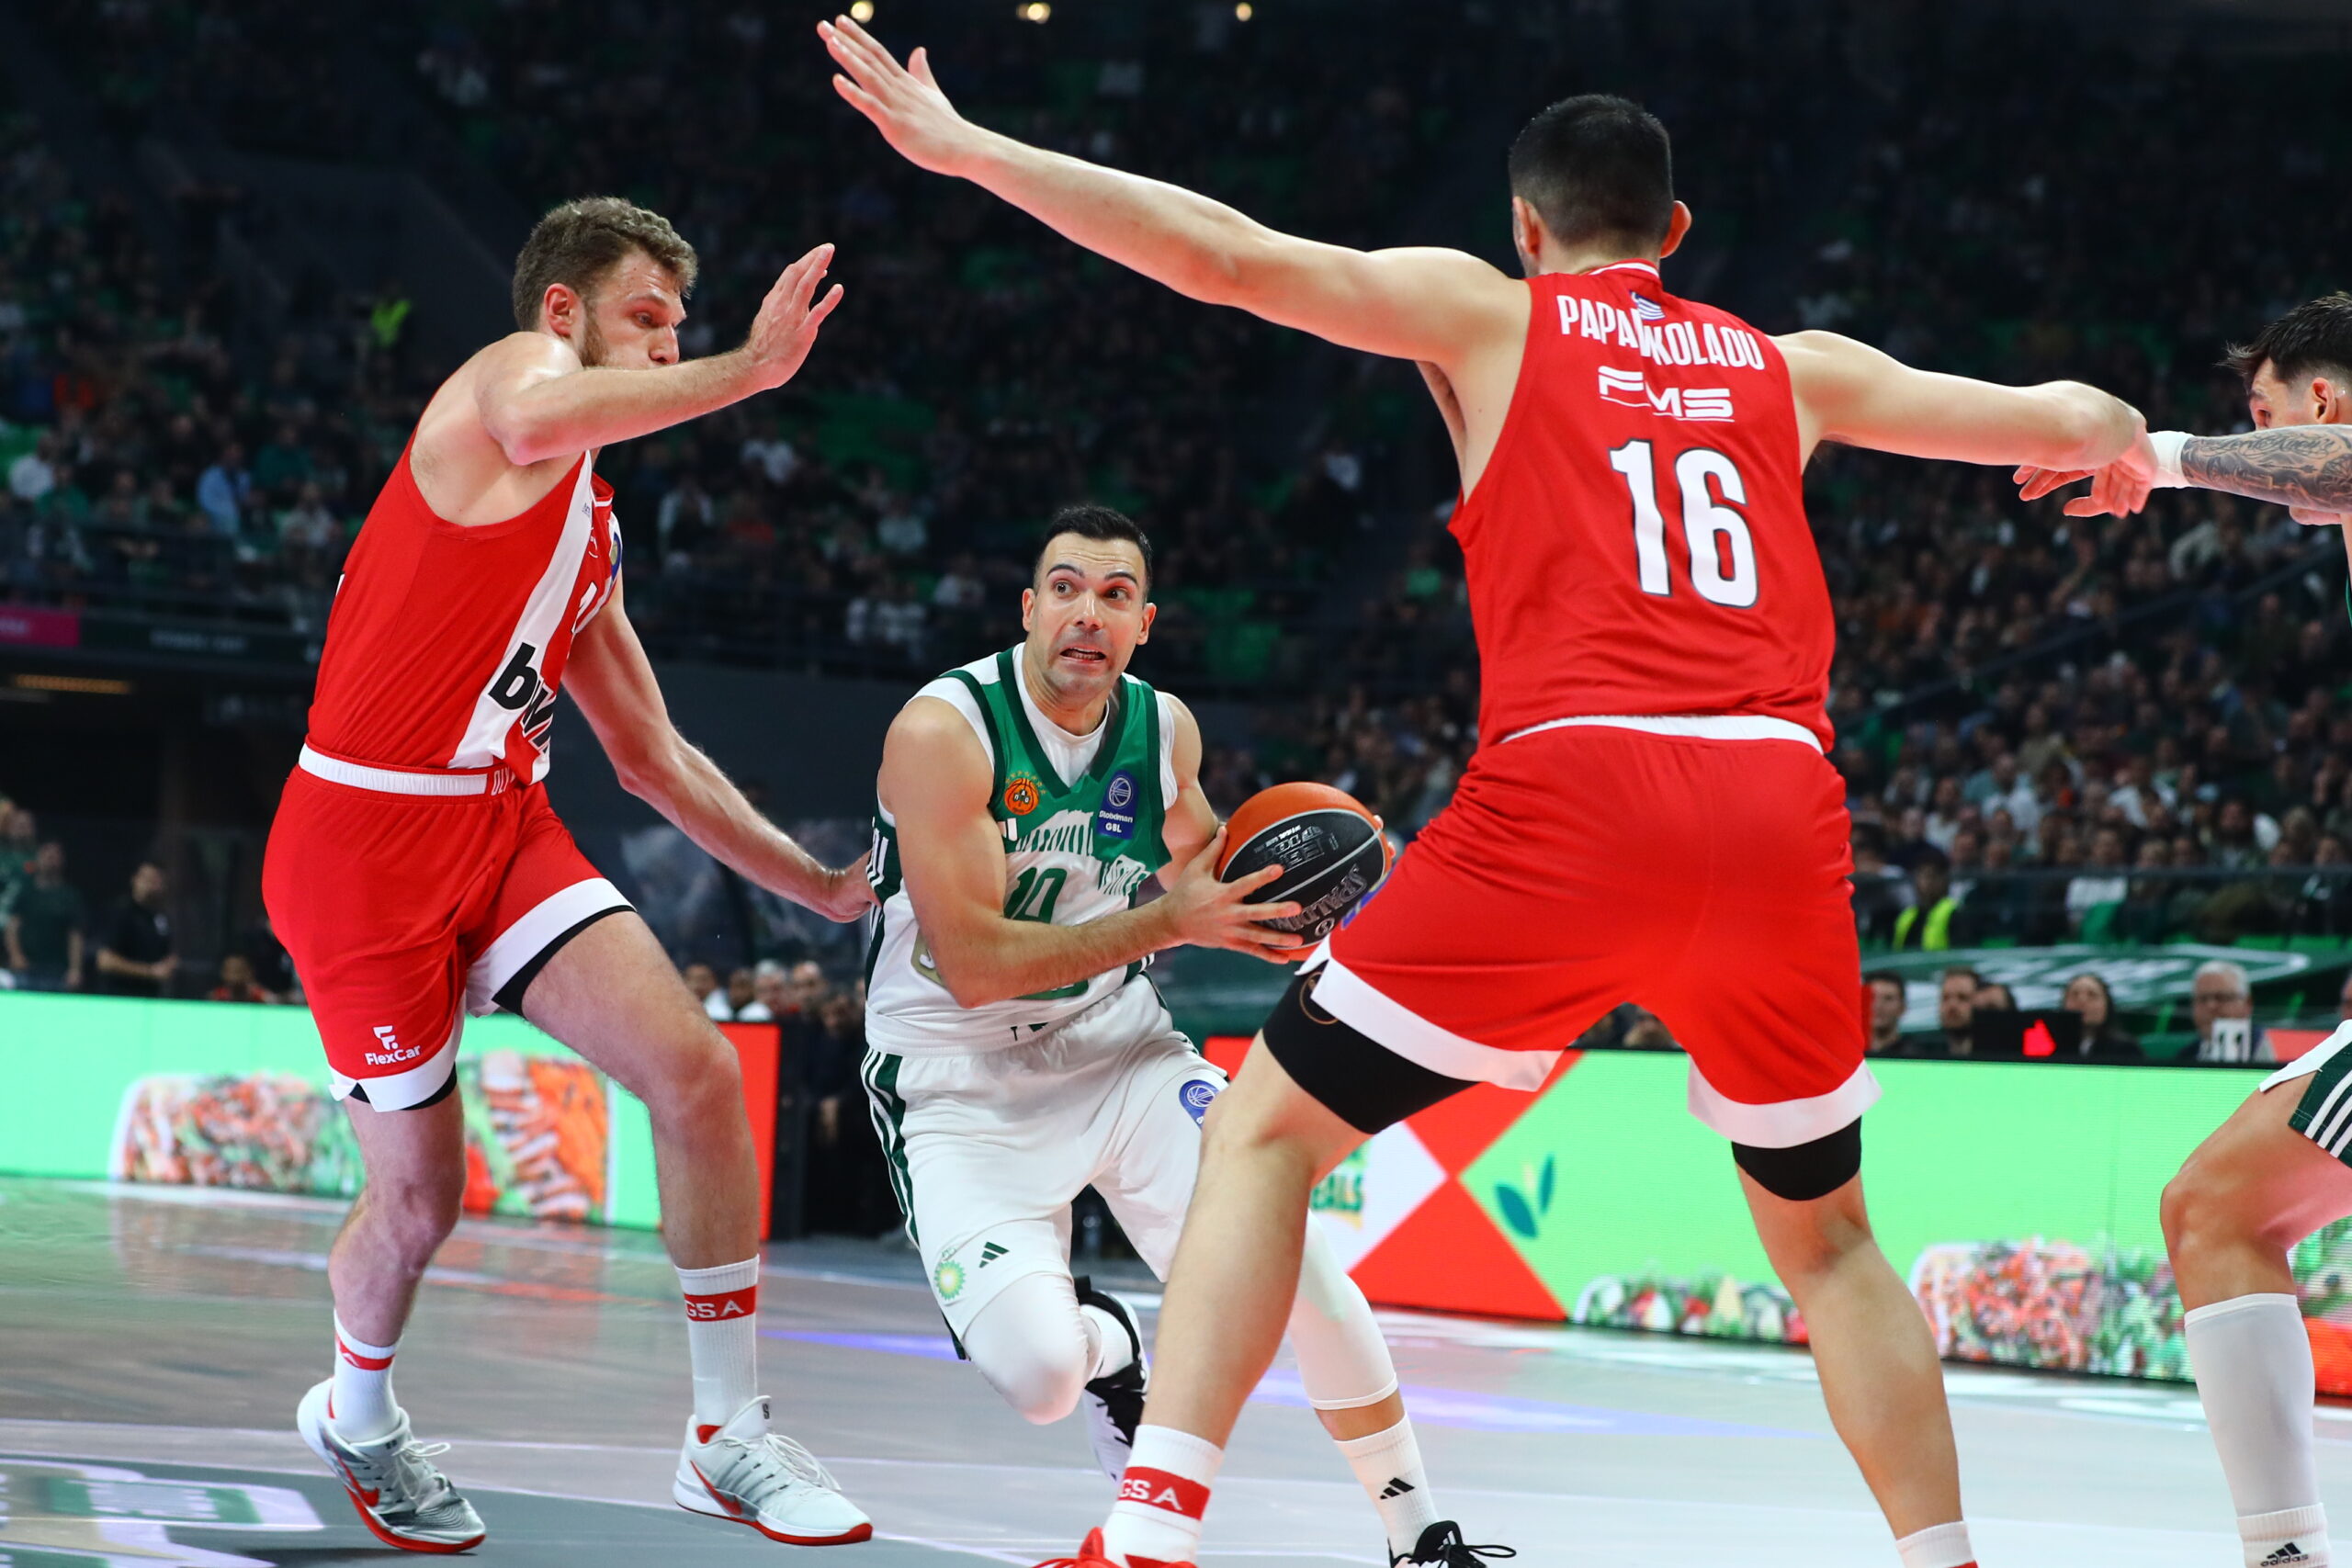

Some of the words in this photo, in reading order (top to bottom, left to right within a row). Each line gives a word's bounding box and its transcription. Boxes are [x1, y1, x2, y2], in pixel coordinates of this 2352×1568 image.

[1608, 437, 1759, 608] 16
[1105, 822, 1123, 833] GBL
[1003, 866, 1069, 921] 10
[365, 1045, 422, 1066] FlexCar
[2260, 1554, 2309, 1567] adidas
